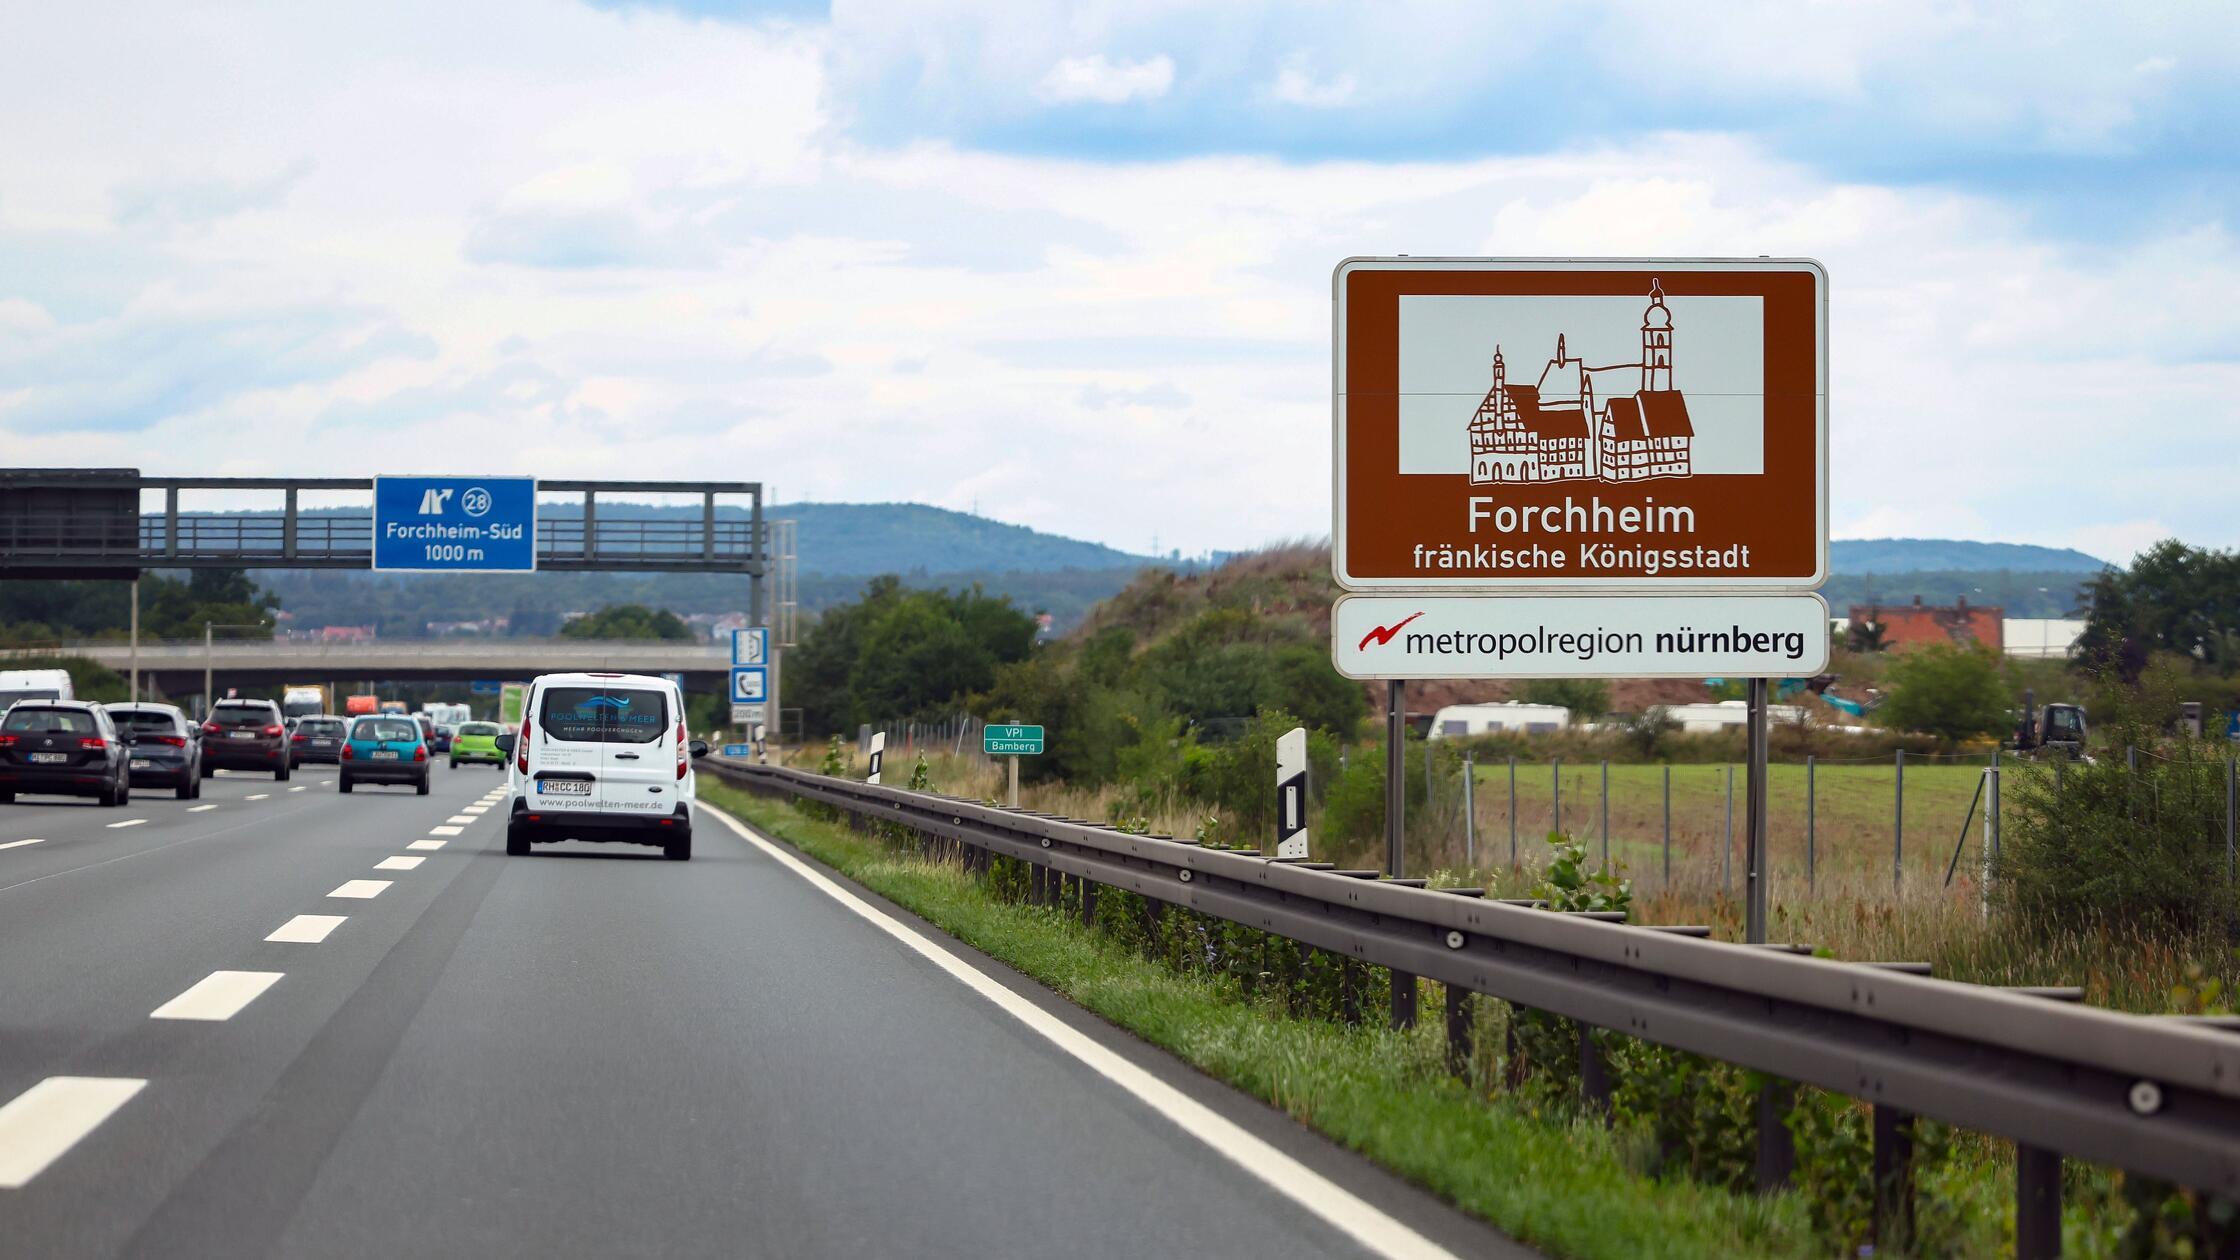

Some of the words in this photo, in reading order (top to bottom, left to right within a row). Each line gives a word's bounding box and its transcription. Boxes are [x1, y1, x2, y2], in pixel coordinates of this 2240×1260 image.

[466, 493, 487, 511] 28
[1470, 497, 1694, 532] Forchheim
[387, 523, 522, 539] Forchheim-Süd
[425, 545, 464, 560] 1000
[468, 549, 483, 560] m
[1414, 544, 1565, 568] fränkische
[1581, 544, 1749, 574] Königsstadt
[1406, 626, 1643, 660] metropolregion
[1657, 625, 1803, 659] nürnberg
[630, 714, 657, 724] MEER
[1005, 727, 1023, 738] VPI
[992, 741, 1035, 752] Bamberg
[560, 783, 571, 792] CC
[540, 799, 663, 810] www.poolwelten-meer.de
